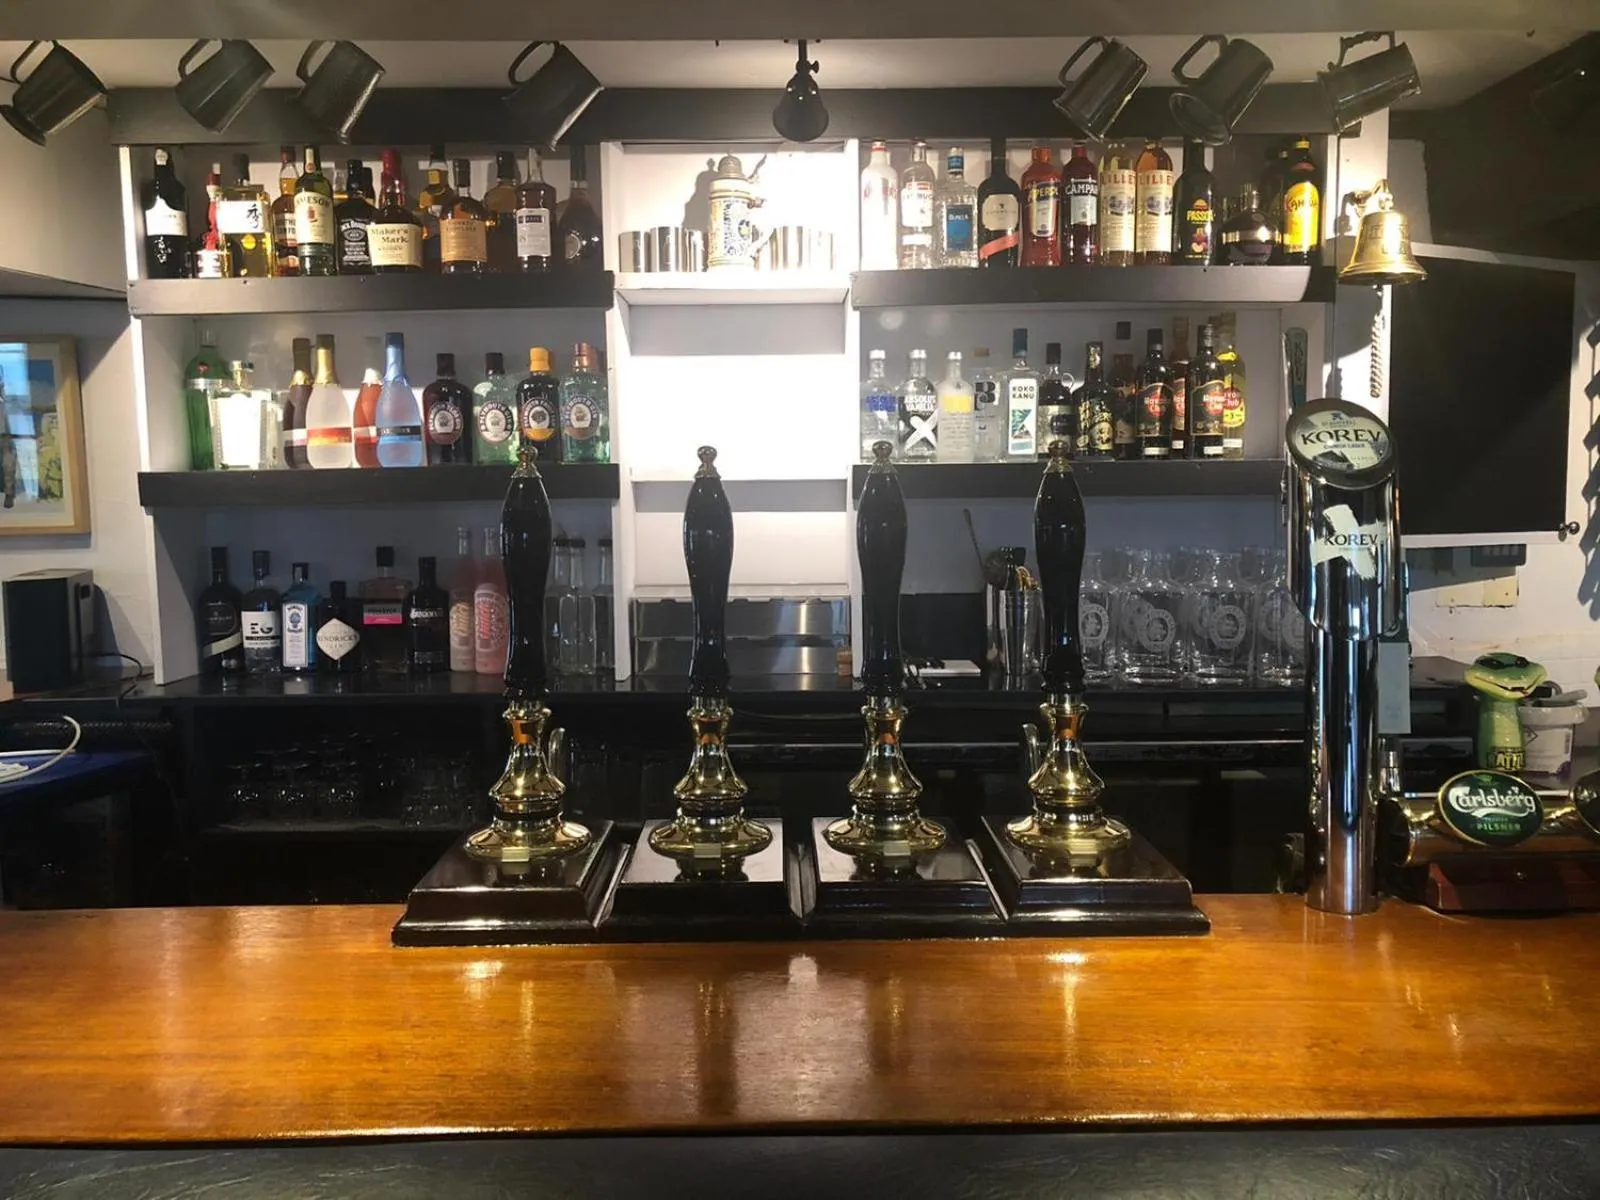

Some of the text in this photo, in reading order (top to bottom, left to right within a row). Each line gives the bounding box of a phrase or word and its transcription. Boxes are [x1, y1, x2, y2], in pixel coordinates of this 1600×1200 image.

[1139, 173, 1173, 186] LILLE
[1301, 428, 1381, 446] KOREV
[1325, 533, 1377, 546] KOREV
[1449, 786, 1536, 814] Carlsberg
